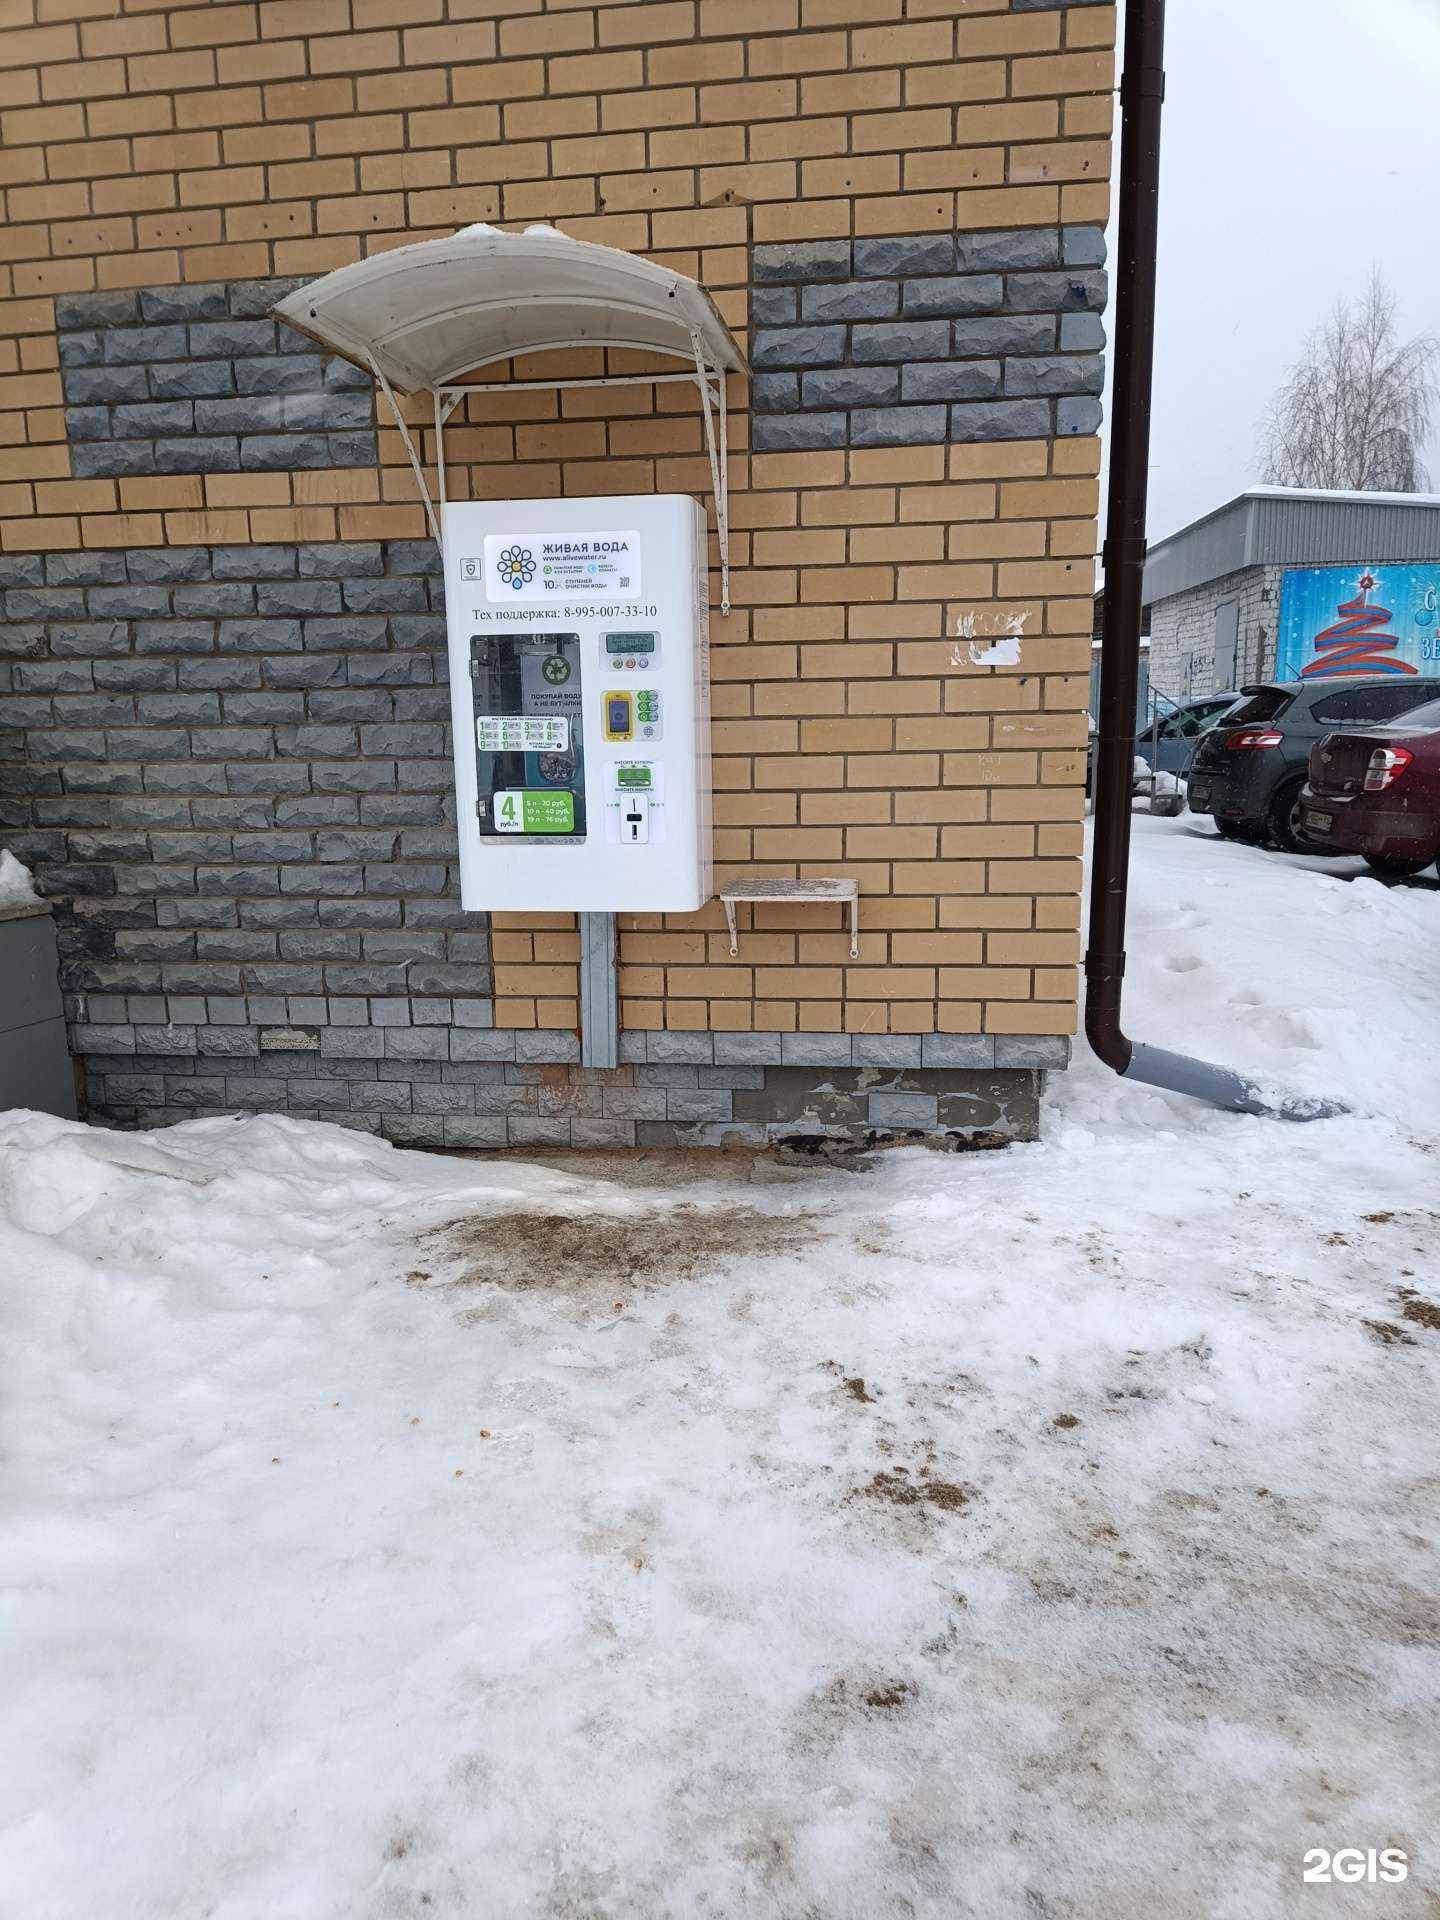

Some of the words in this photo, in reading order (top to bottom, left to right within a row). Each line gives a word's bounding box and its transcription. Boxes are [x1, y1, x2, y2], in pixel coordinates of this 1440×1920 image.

[542, 542, 588, 553] ЖИВАЯ
[593, 541, 629, 552] ВОДА
[543, 580, 555, 589] 10
[472, 609, 492, 620] Тех
[496, 610, 560, 621] поддержка:
[564, 605, 657, 618] 8-995-007-33-10
[502, 796, 516, 820] 4
